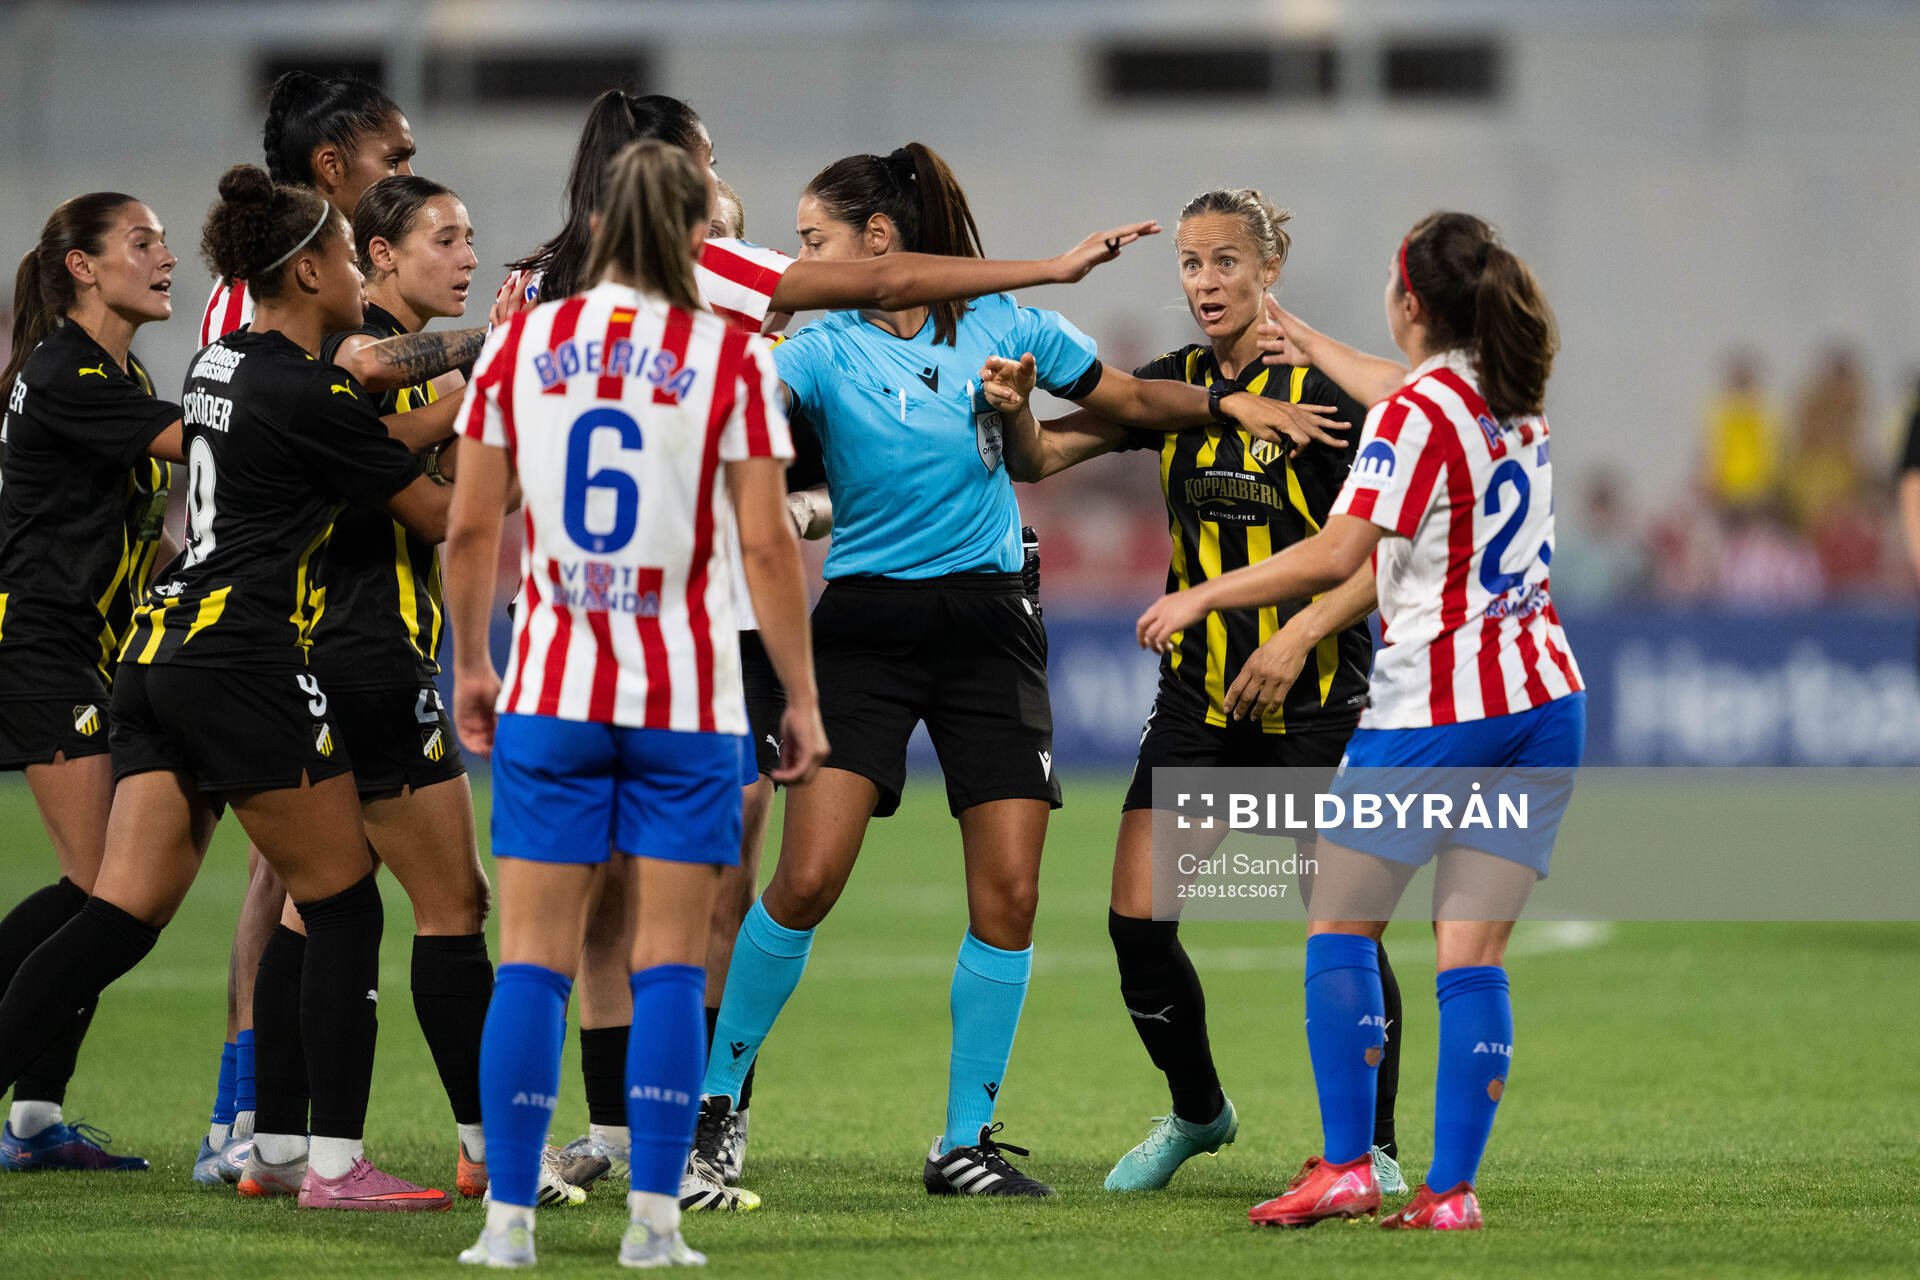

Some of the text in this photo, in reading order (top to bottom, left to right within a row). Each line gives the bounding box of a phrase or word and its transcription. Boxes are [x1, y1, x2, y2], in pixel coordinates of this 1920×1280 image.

[533, 337, 697, 400] BØERISA
[563, 407, 643, 554] 6
[1205, 470, 1256, 481] PREMIUM CIDER
[1209, 510, 1257, 521] ALCOHOL-FREE
